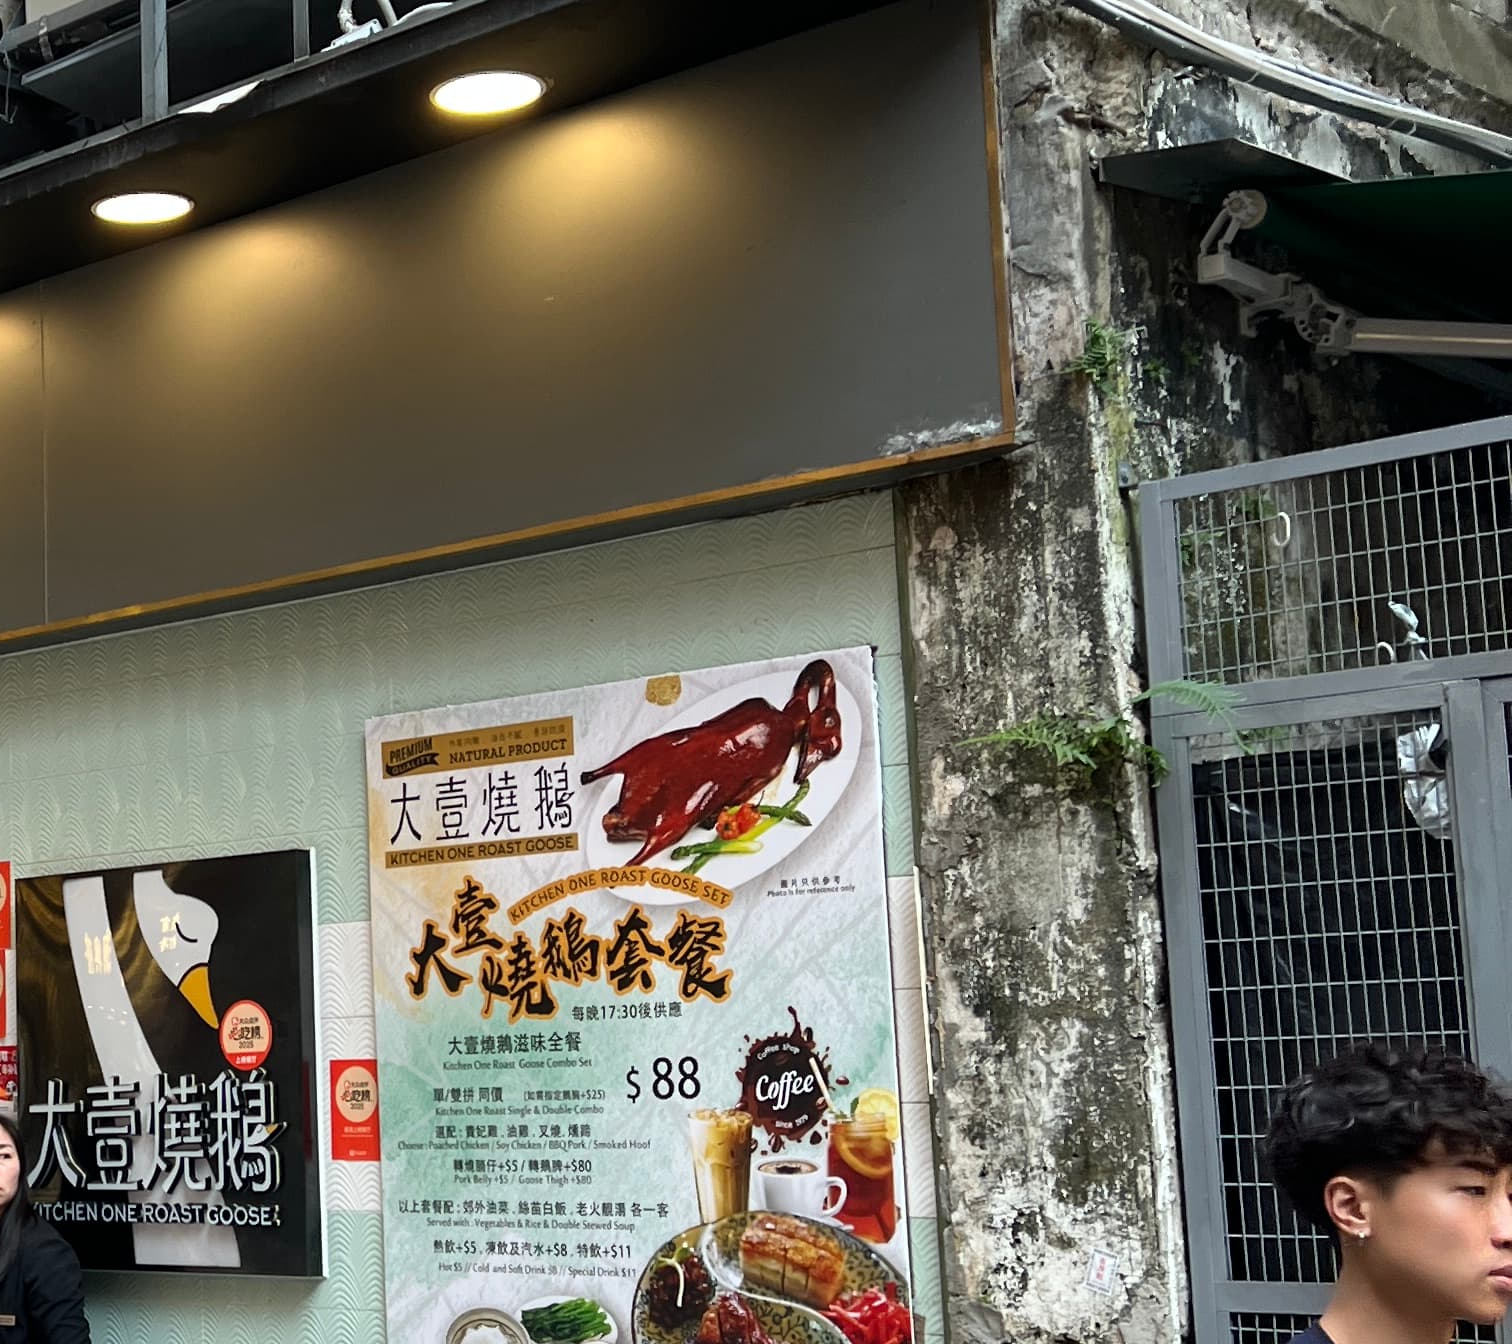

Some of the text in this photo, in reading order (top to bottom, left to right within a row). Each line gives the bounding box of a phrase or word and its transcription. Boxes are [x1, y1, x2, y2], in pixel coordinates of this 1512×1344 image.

[389, 736, 433, 764] PREMIUM
[449, 738, 568, 765] NATURAL PRODUCT
[390, 762, 575, 846] 大壹燒鵝
[390, 836, 574, 866] KITCHEN ONE ROAST GOOSE
[510, 869, 732, 922] KITCHEN ONE ROAST GOOSE SET
[840, 884, 856, 893] only
[409, 879, 731, 1018] 大壹燒鵝套餐
[571, 1001, 683, 1022] 每晚17:30後供應
[238, 1040, 254, 1049] 2025
[447, 1031, 583, 1057] 大壹燒鵝滋味全餐
[442, 1057, 593, 1071] Kitchen One Roast Goose Combo Set
[755, 1071, 815, 1111] Coffee
[466, 1106, 483, 1116] One
[508, 1105, 533, 1118] Single
[542, 1105, 573, 1115] Double
[574, 1104, 605, 1114] Combo
[27, 1067, 287, 1194] 大壹燒鵝
[460, 1141, 489, 1150] Chicken
[496, 1141, 510, 1152] Soy
[511, 1141, 542, 1151] Chicken
[548, 1140, 568, 1152] BBQ
[568, 1140, 586, 1151] Pork
[592, 1140, 627, 1150] Smoked
[629, 1140, 652, 1150] Hoof
[454, 1174, 471, 1185] Pork
[473, 1174, 492, 1186] Belly
[518, 1175, 544, 1185] Goose
[546, 1174, 569, 1187] Thigh
[33, 1201, 275, 1226] ITCHEN ONE ROAST GOOSE
[426, 1217, 452, 1227] Served
[524, 1219, 542, 1229] Rice
[551, 1220, 581, 1230] Double
[582, 1220, 612, 1231] Stewed
[614, 1221, 636, 1233] Soup
[439, 1262, 453, 1272] Hot
[472, 1262, 490, 1273] Cold
[492, 1264, 507, 1274] and
[507, 1263, 523, 1274] Soft
[524, 1264, 546, 1275] Drink
[568, 1266, 596, 1278] Special
[597, 1267, 620, 1277] Drink
